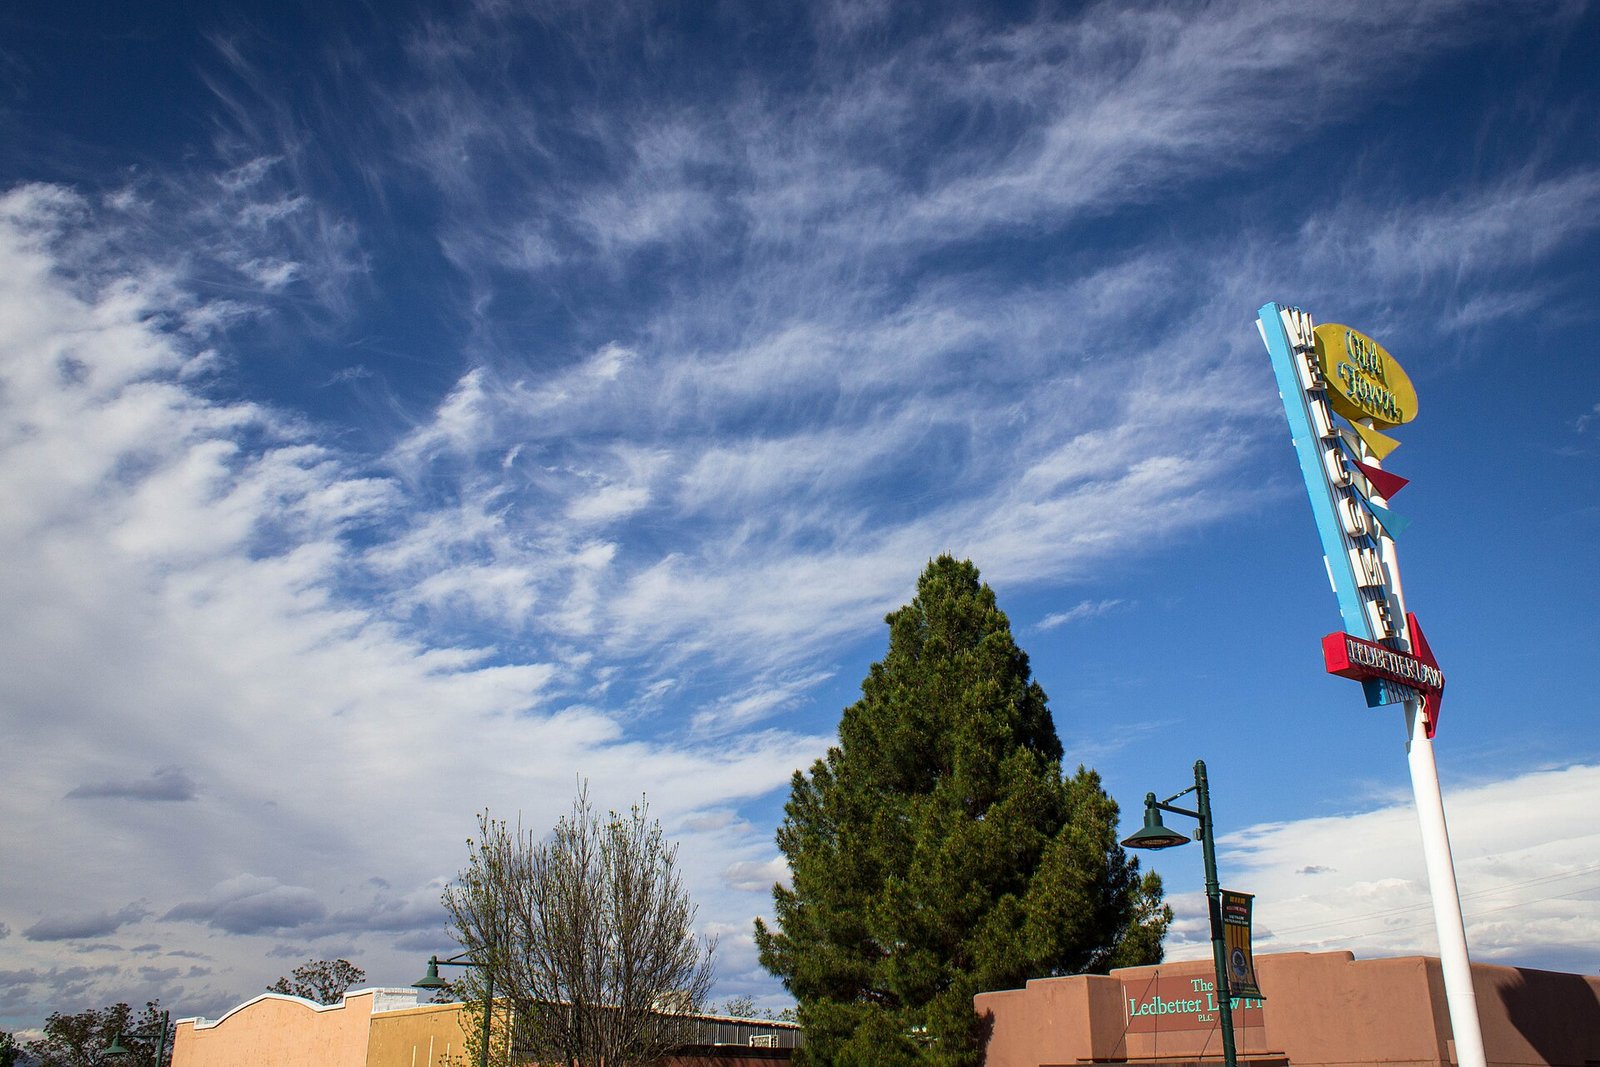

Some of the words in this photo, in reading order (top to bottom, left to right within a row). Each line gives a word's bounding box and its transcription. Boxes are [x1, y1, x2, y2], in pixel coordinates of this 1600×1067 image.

[1338, 362, 1401, 420] Town
[1280, 307, 1398, 641] WELCOME
[1346, 639, 1414, 679] LEDBETTER
[1129, 998, 1202, 1017] Ledbetter
[1206, 993, 1240, 1011] Lw
[1191, 978, 1214, 993] The
